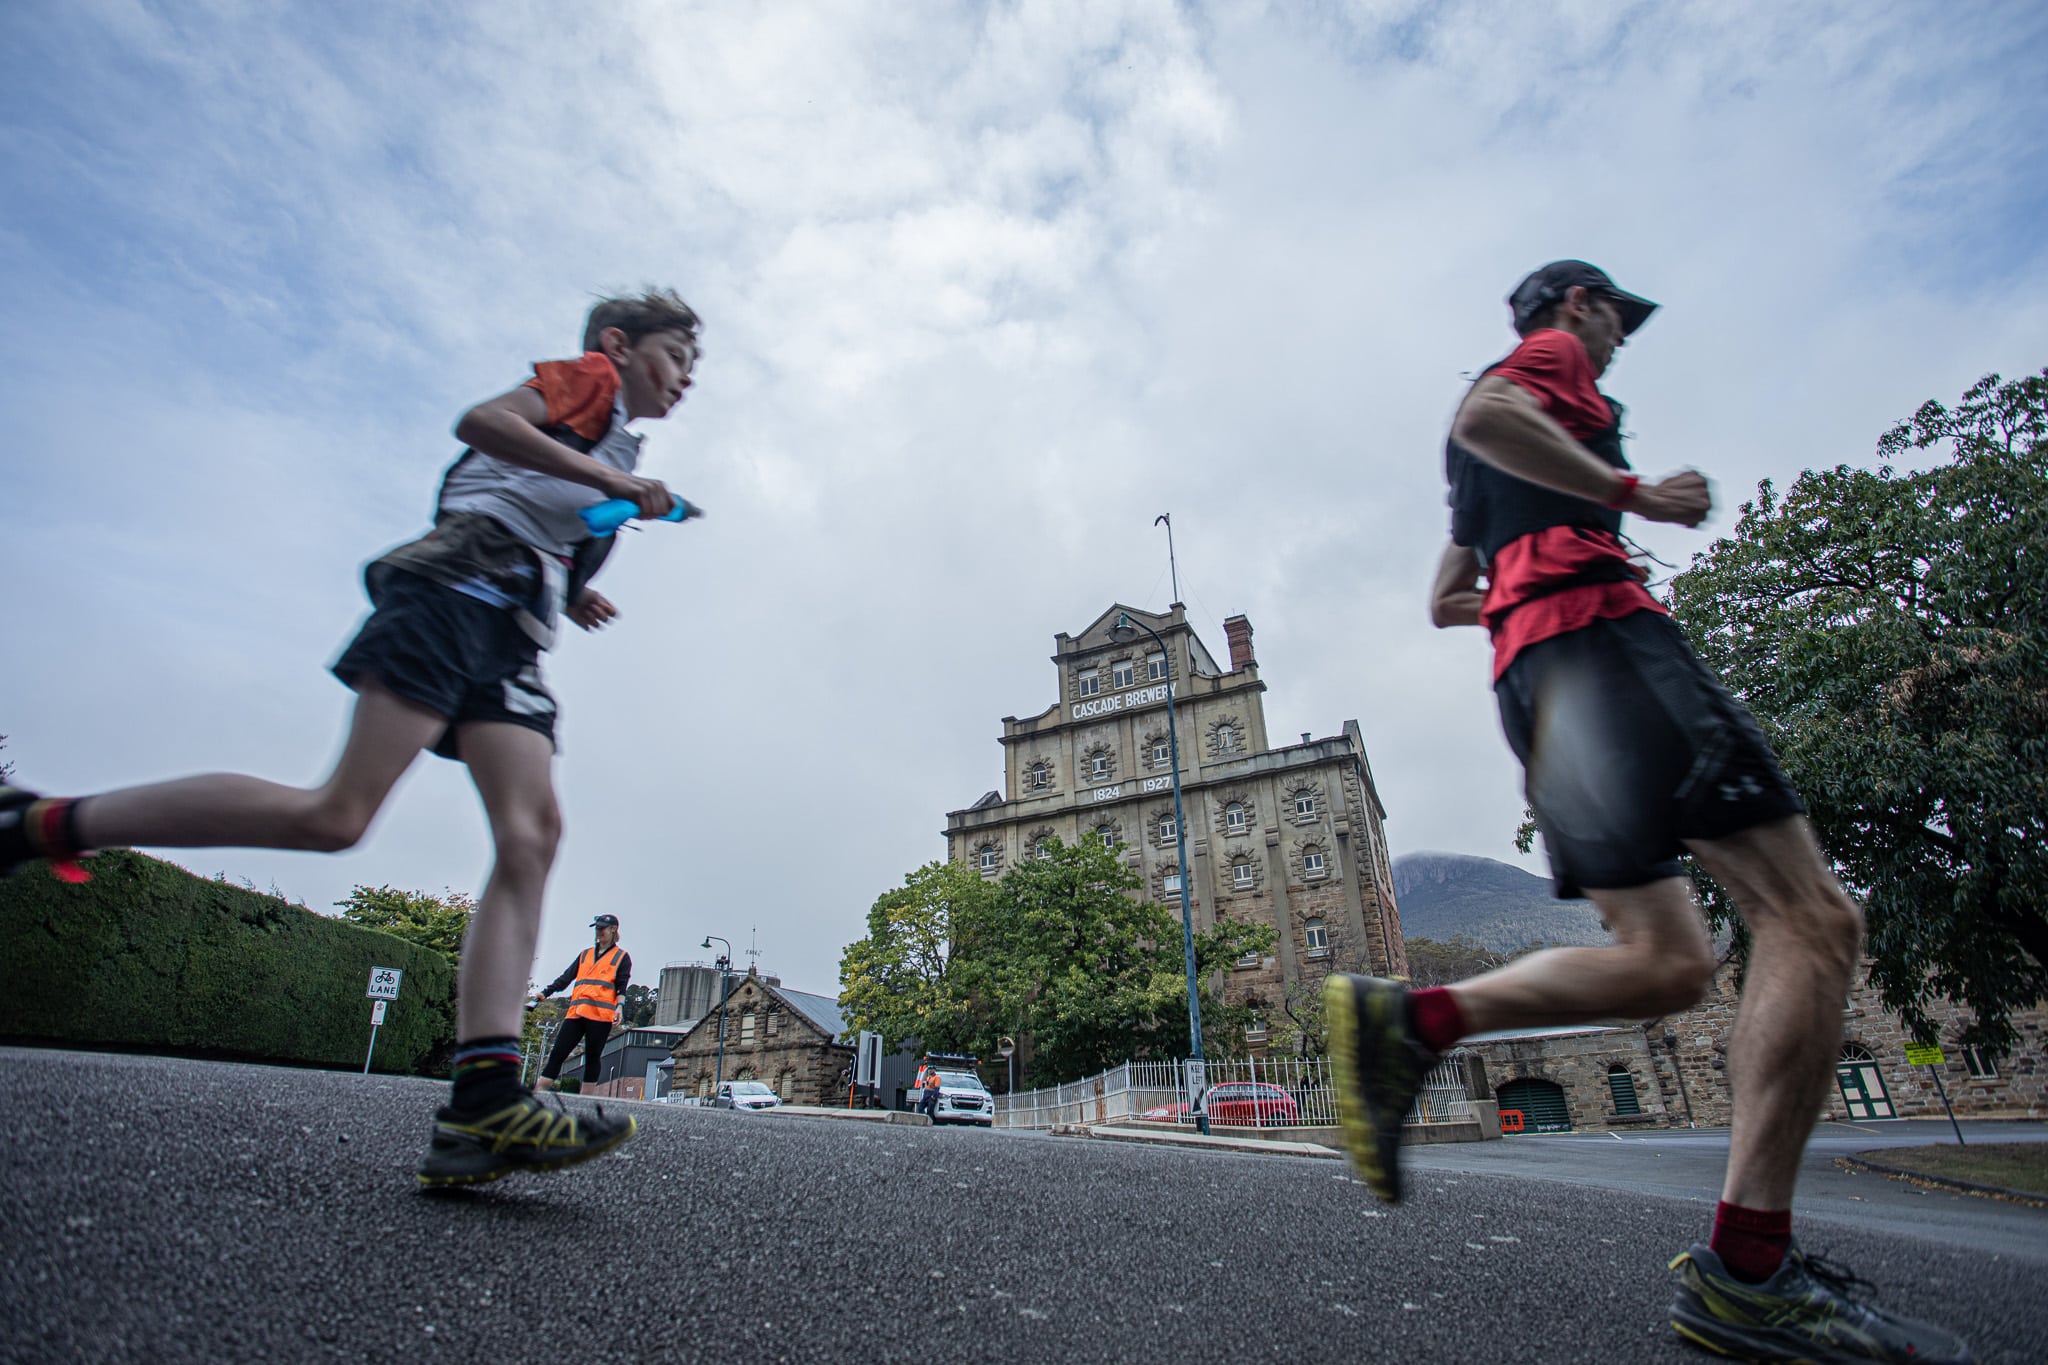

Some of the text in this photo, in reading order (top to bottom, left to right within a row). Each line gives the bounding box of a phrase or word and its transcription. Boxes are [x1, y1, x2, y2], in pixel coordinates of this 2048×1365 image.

[1072, 682, 1177, 719] CASCADE BREWERY
[1143, 776, 1171, 792] 1927
[1093, 786, 1120, 801] 1824
[370, 984, 396, 995] LANE
